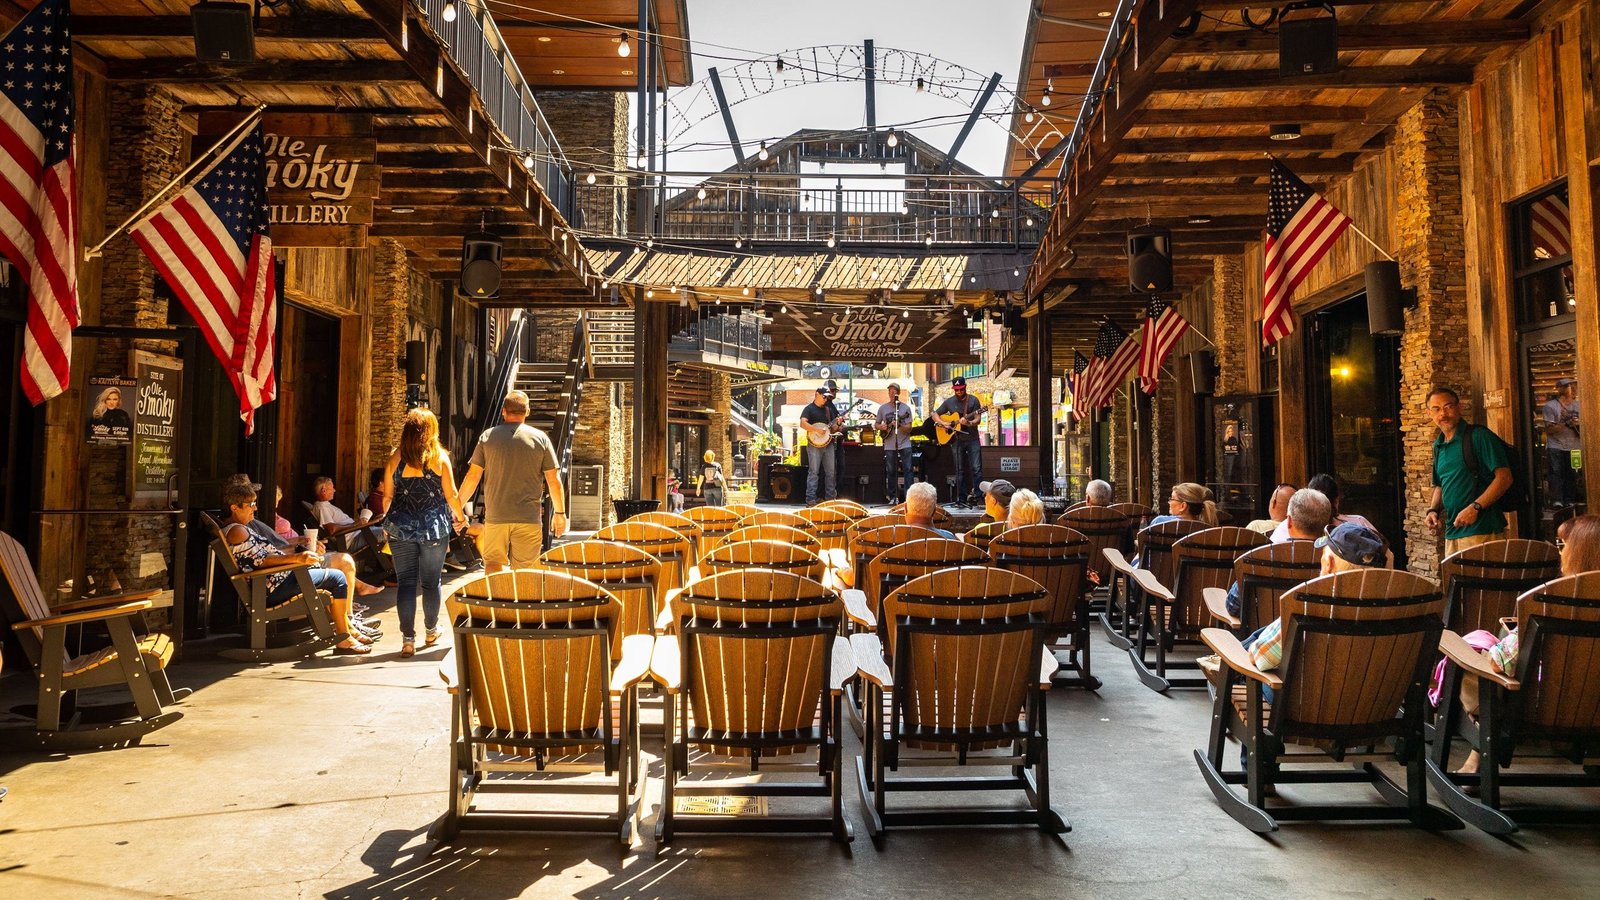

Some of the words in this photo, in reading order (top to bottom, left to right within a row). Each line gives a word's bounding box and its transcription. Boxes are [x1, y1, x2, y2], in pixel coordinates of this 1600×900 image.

[266, 144, 361, 200] oky
[270, 205, 352, 224] ILLERY
[823, 310, 913, 347] Smoky
[831, 342, 904, 359] Moonshine
[151, 381, 164, 396] Ole
[137, 385, 175, 425] Smoky
[137, 422, 174, 438] DISTILLERY
